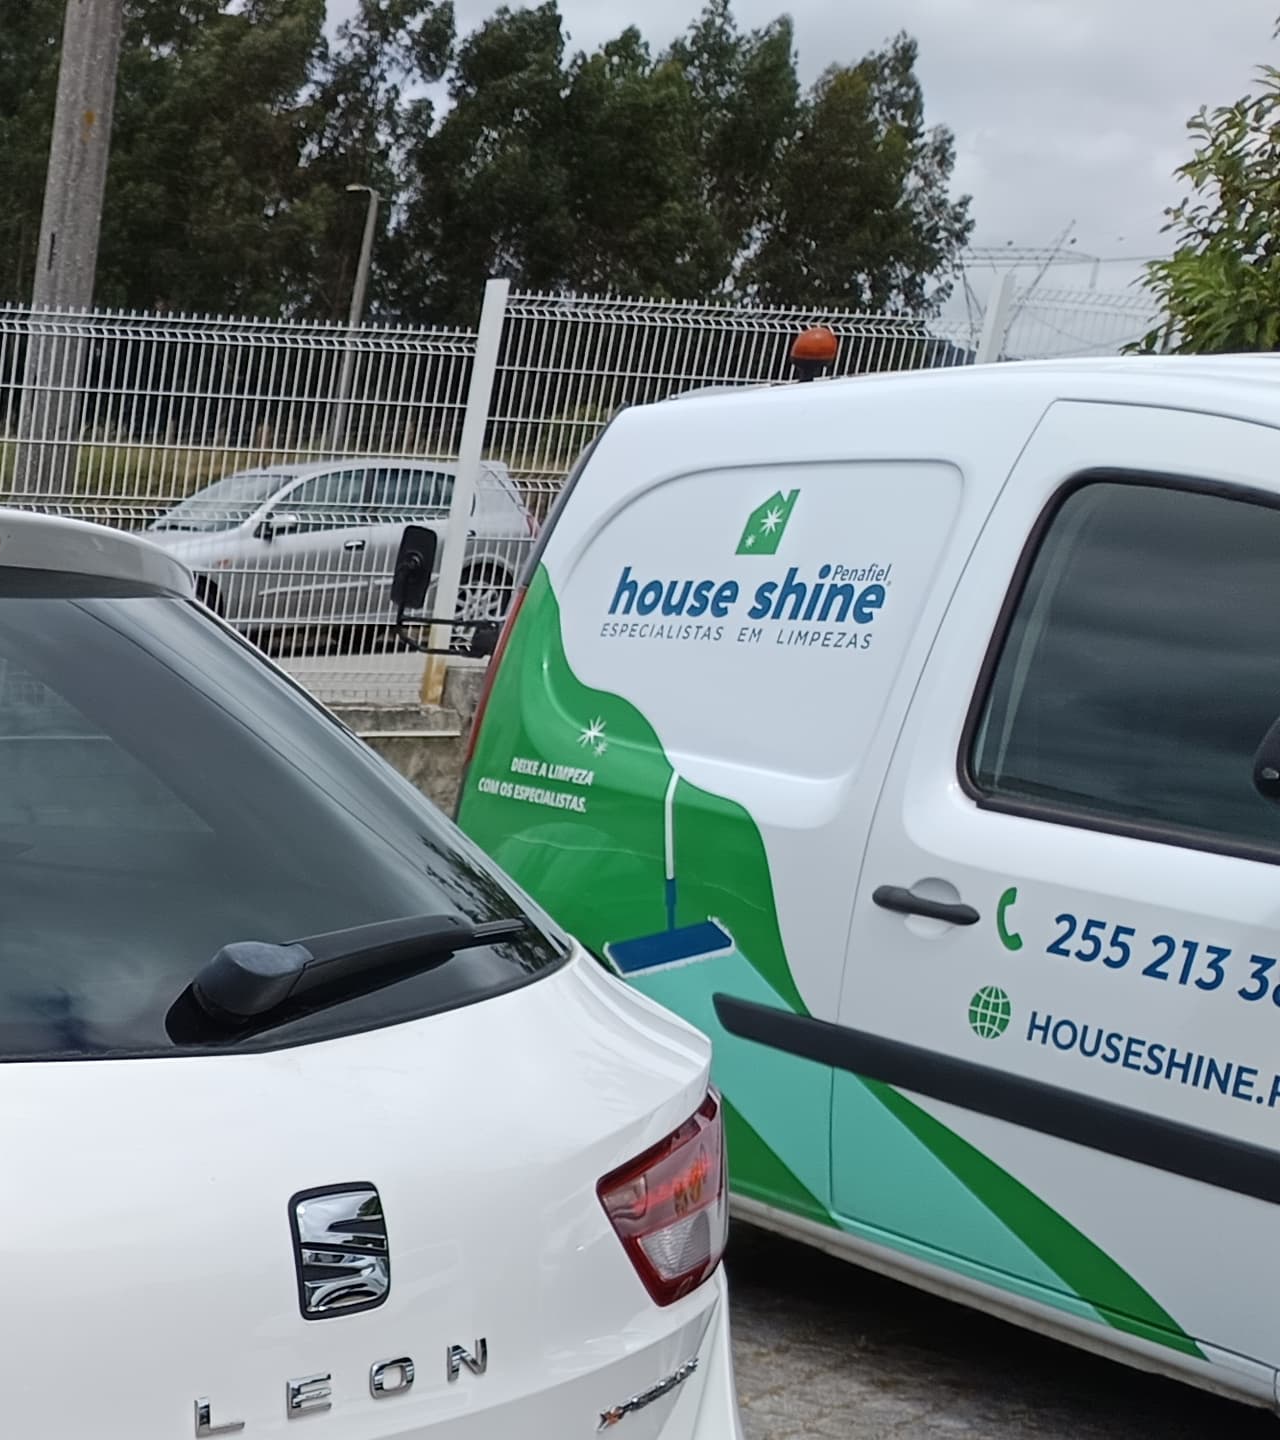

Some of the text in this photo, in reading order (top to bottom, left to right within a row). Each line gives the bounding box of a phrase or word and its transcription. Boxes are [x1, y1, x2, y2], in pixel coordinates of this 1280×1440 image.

[832, 563, 892, 583] Penafiel
[607, 563, 887, 625] house shine
[600, 622, 873, 650] ESPECIALISTAS EM LIMPEZAS
[510, 757, 595, 786] DEIXE A LIMPEZA
[478, 777, 500, 795] COM
[500, 781, 514, 798] OS
[1046, 913, 1136, 969] 255
[1142, 934, 1232, 991] 213
[194, 1337, 489, 1439] LEON
